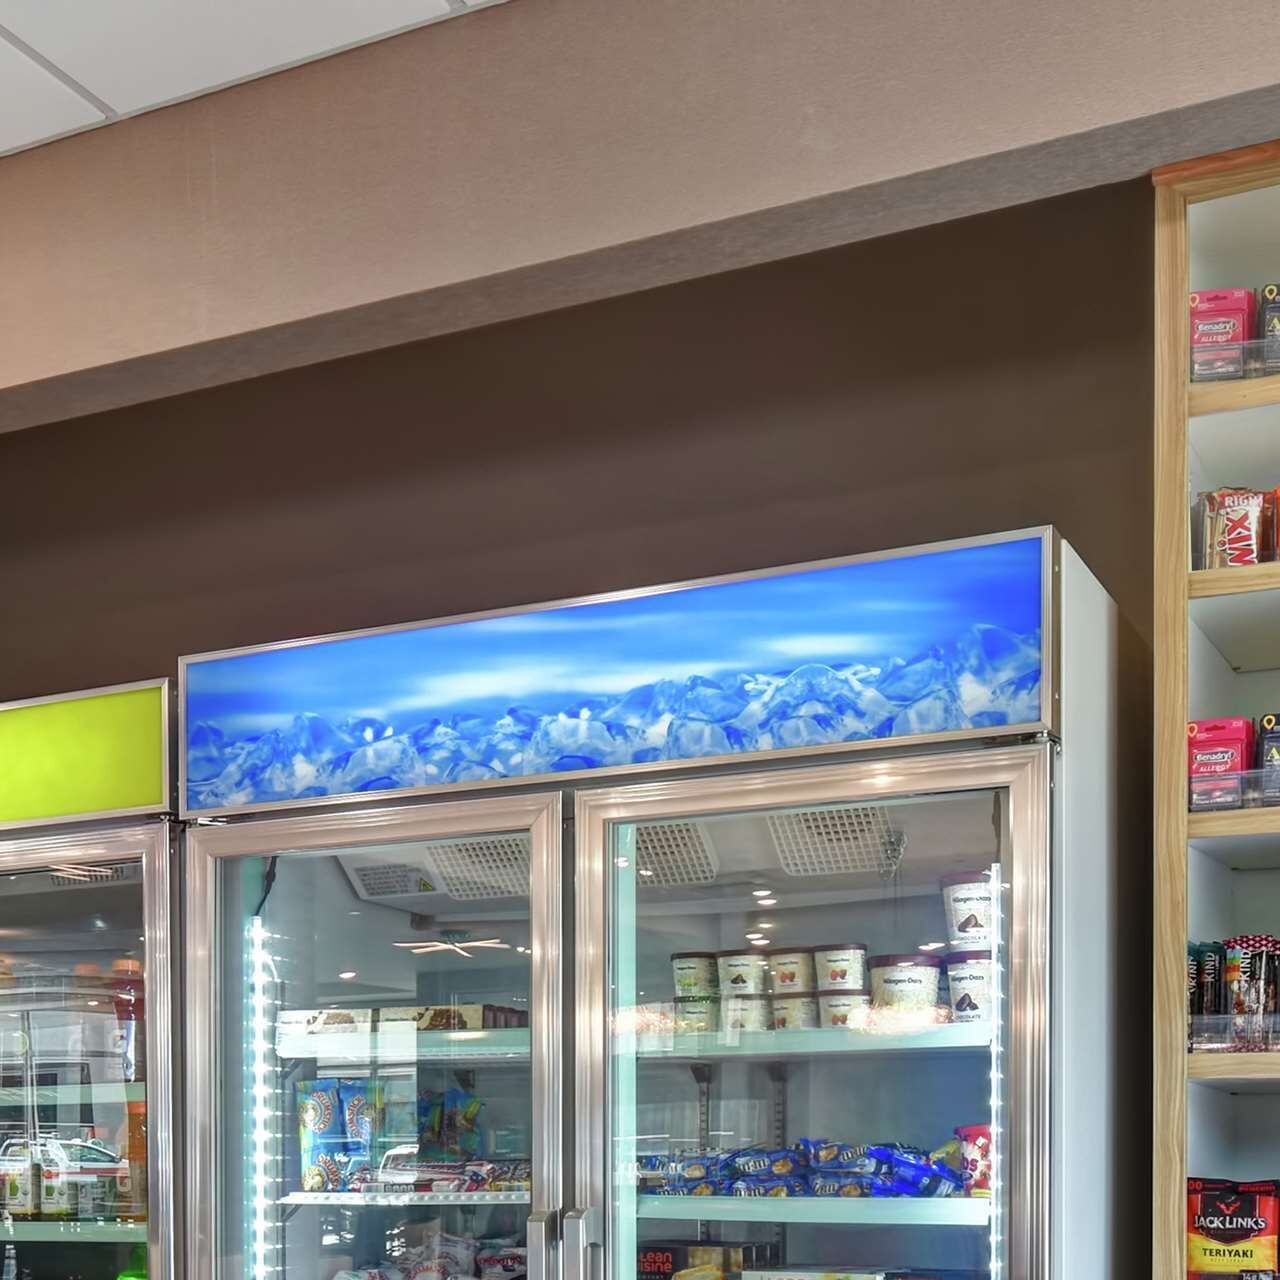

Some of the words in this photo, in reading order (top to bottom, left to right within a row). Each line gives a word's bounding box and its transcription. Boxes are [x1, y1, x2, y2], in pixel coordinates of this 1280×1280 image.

[1204, 952, 1216, 983] KIND
[1193, 1215, 1224, 1230] JACK
[1224, 1213, 1267, 1230] LINK'S
[1202, 1247, 1254, 1259] TERIYAKI
